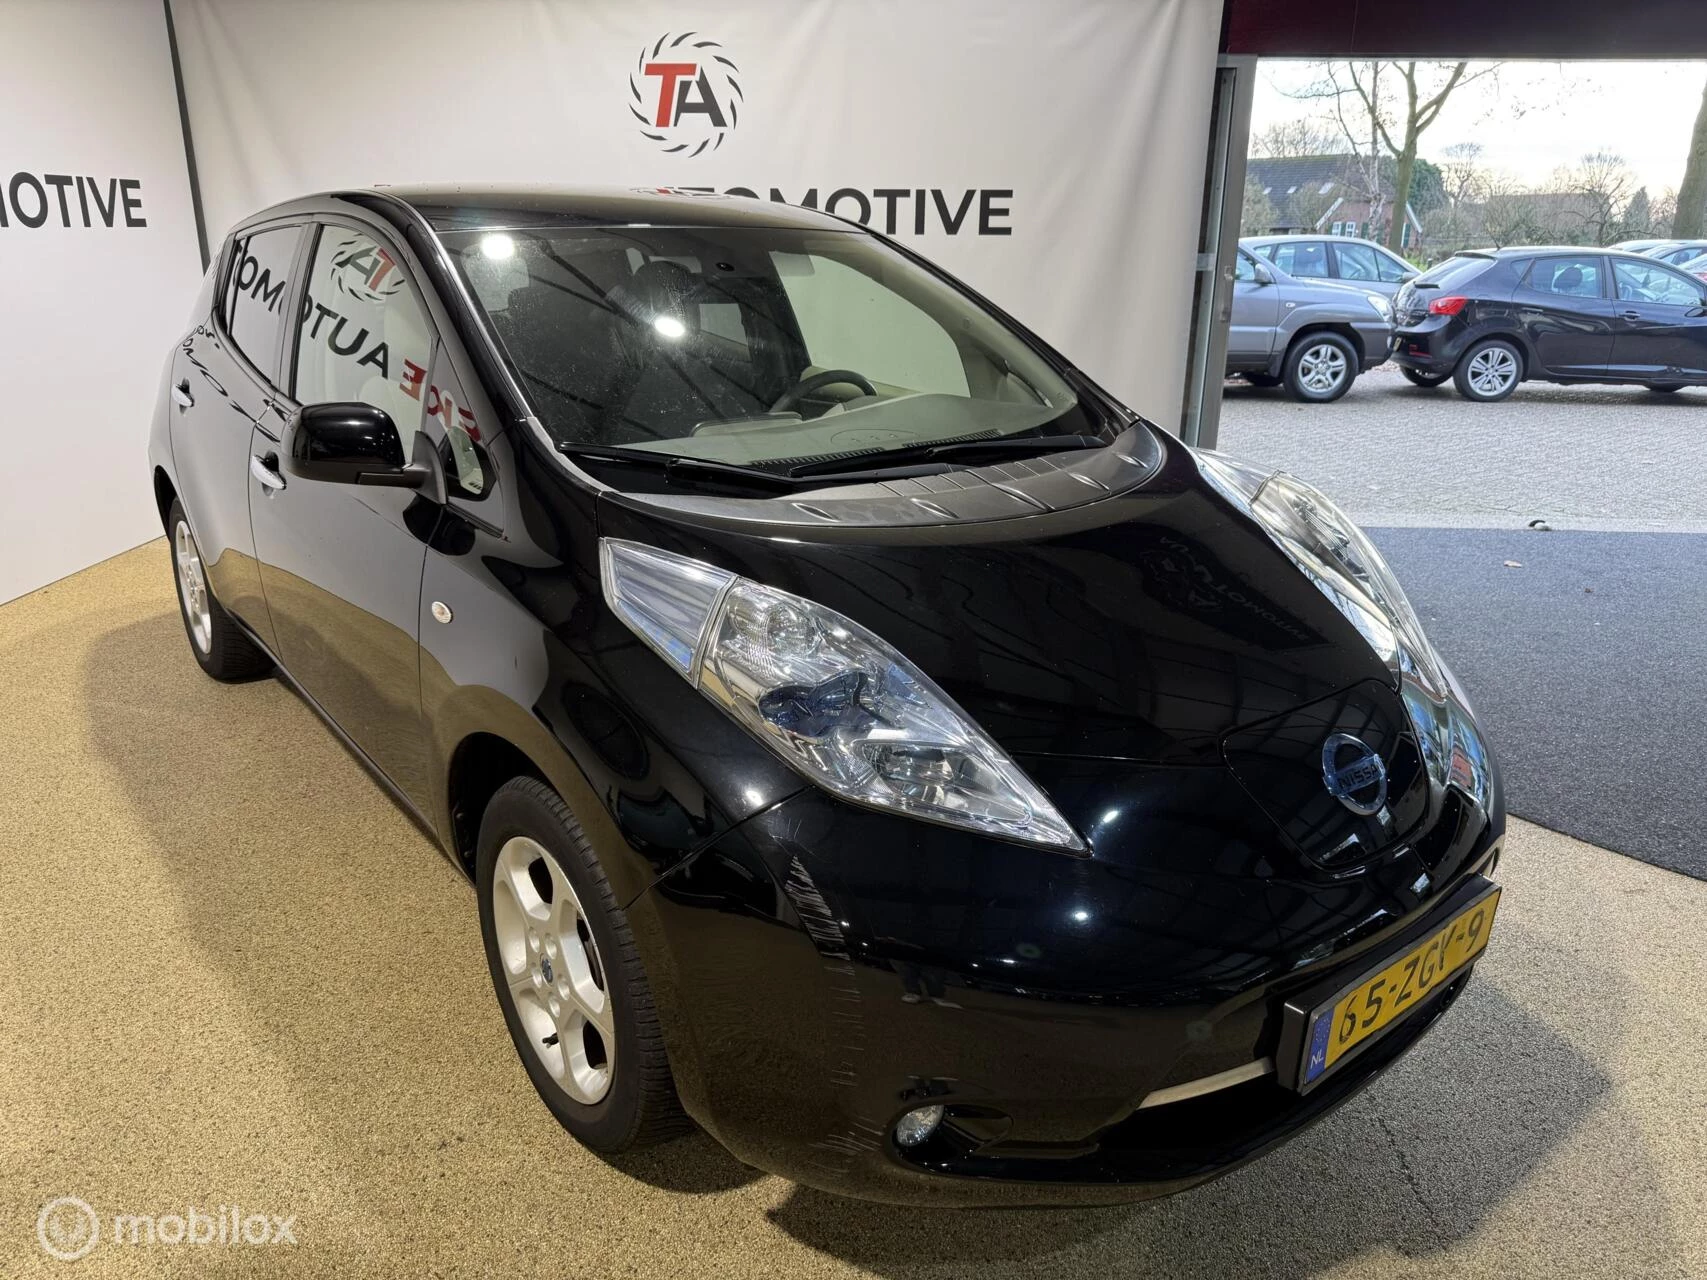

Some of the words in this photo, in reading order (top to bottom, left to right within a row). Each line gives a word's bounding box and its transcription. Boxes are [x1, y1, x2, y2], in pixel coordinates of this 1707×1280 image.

[644, 63, 728, 127] TA
[0, 171, 147, 229] OTIVE
[1310, 1053, 1324, 1068] NL
